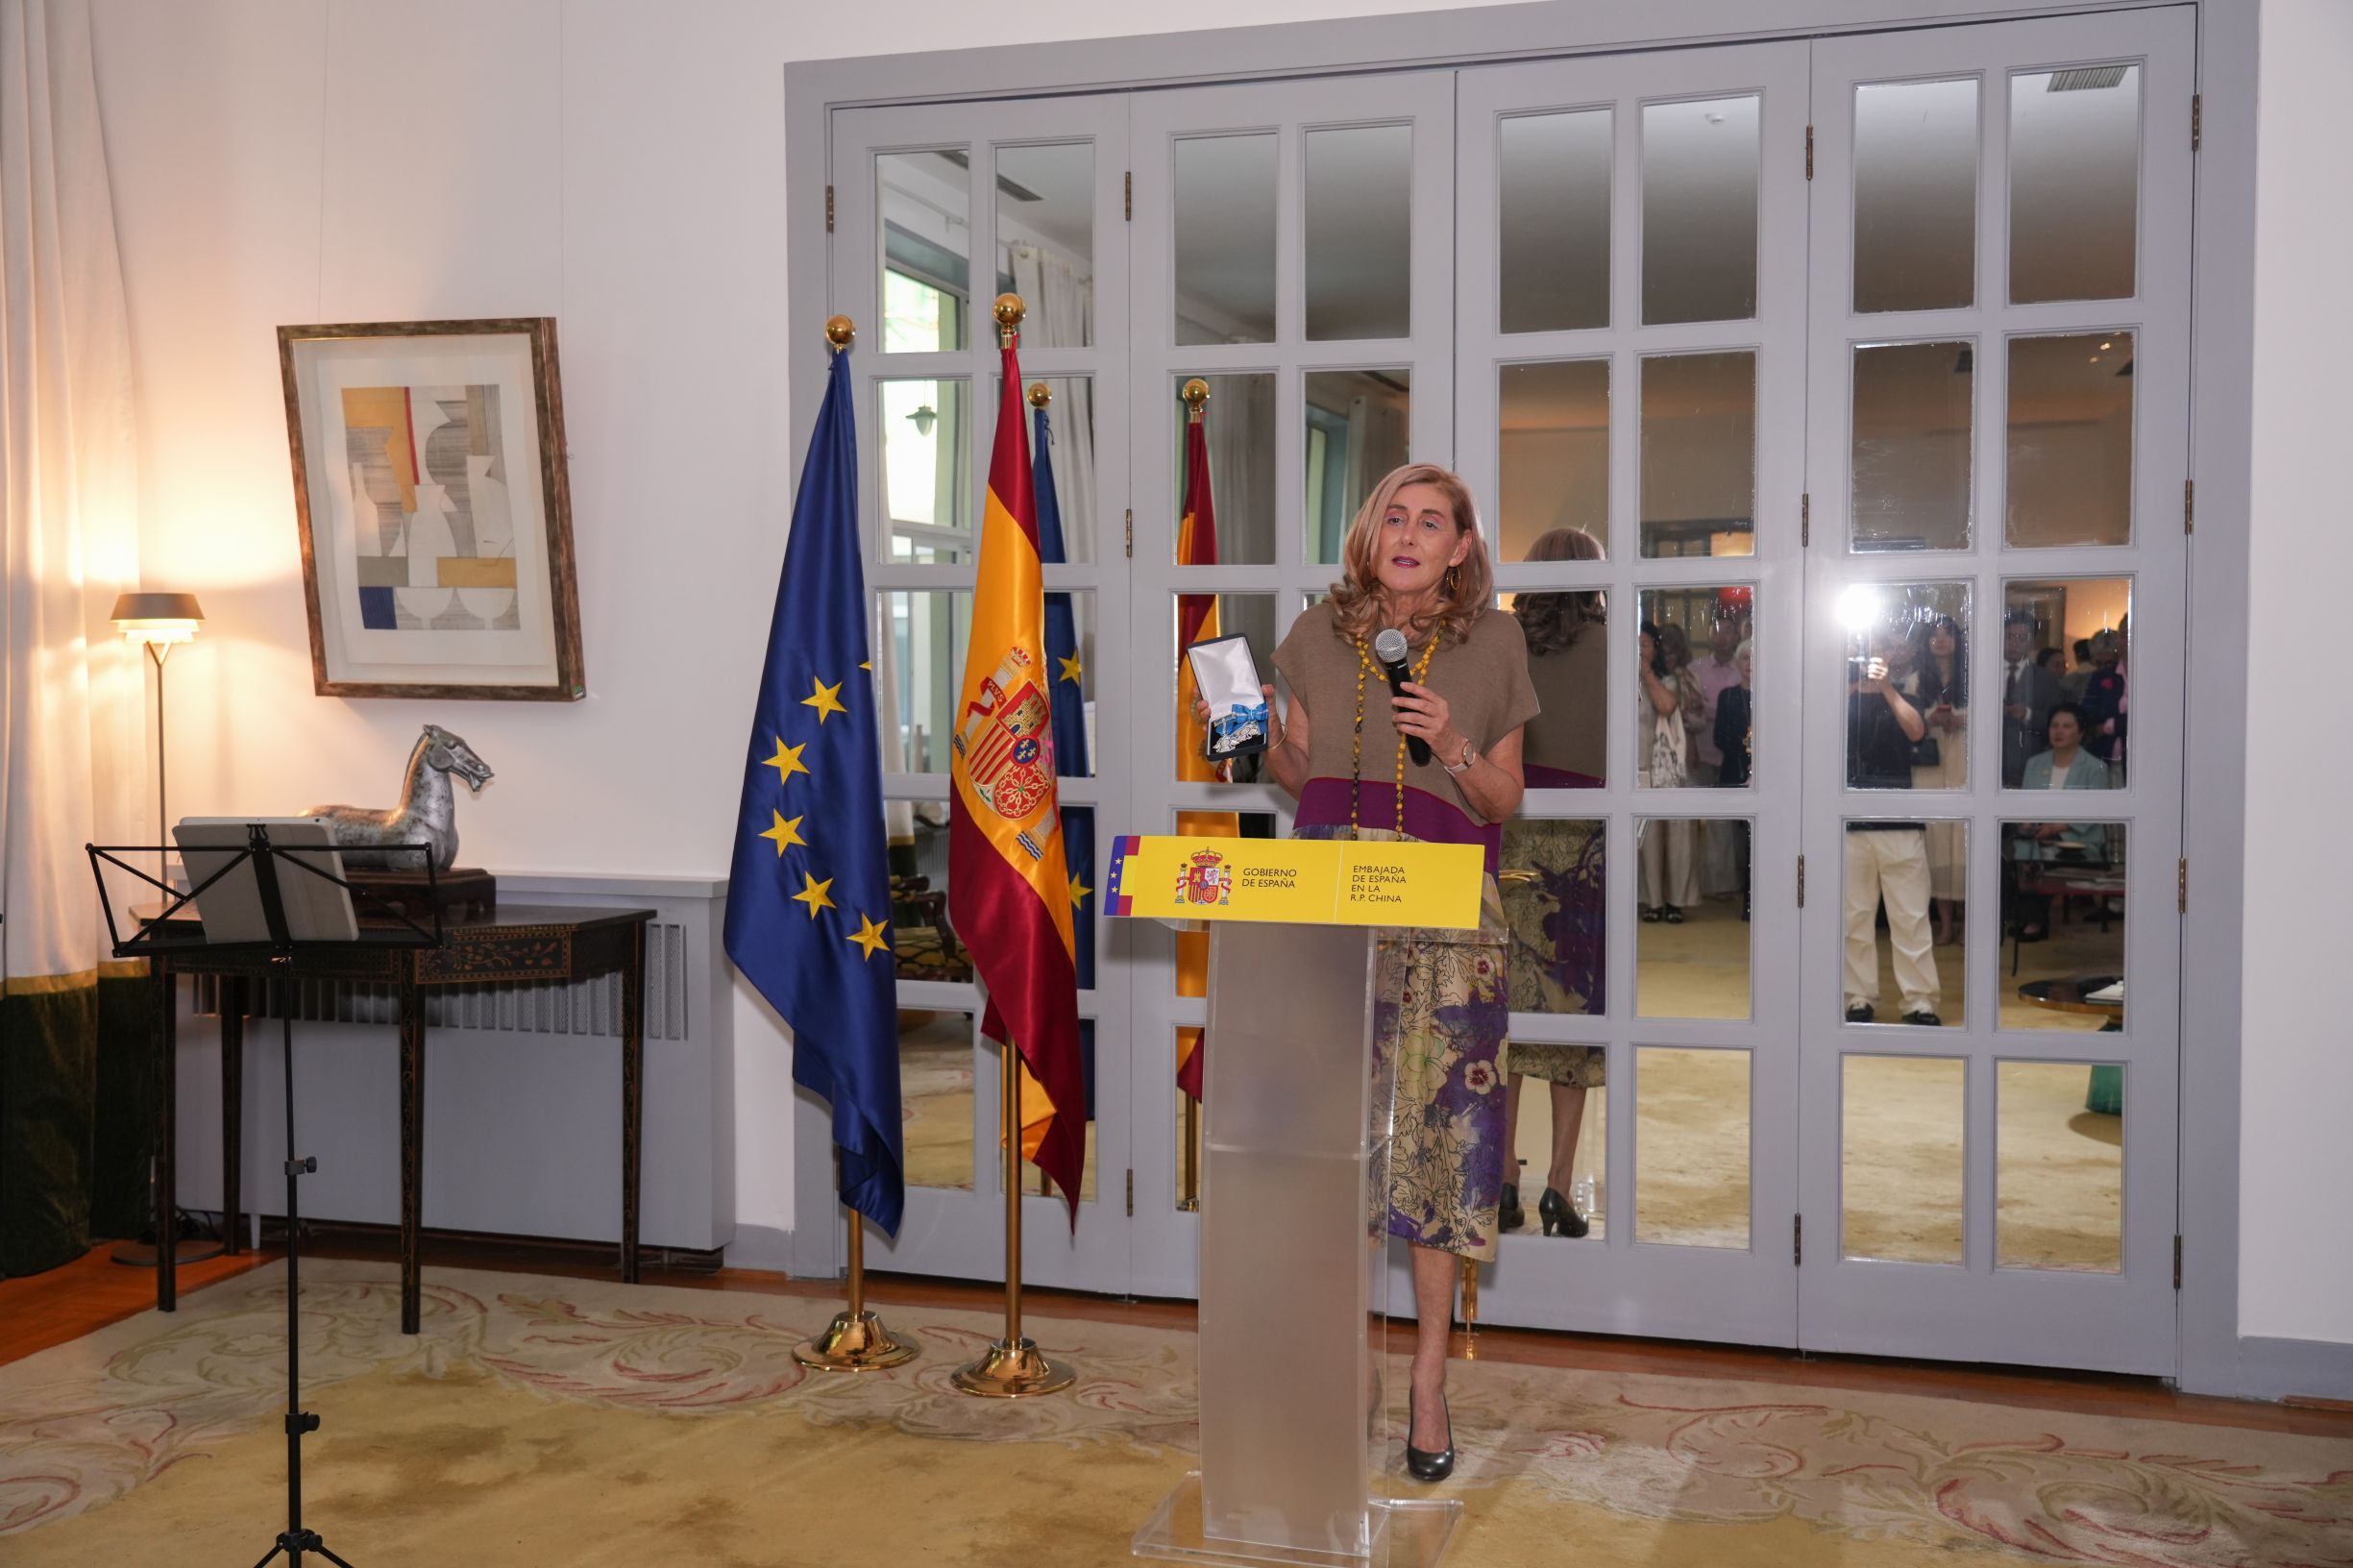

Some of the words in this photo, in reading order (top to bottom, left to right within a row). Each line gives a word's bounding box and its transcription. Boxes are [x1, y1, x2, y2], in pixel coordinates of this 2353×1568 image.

[1242, 868, 1297, 877] GOBIERNO
[1353, 865, 1405, 875] EMBAJADA
[1241, 878, 1255, 888] DE
[1258, 877, 1295, 888] ESPAÑA
[1352, 874, 1365, 883] DE
[1368, 874, 1407, 884] ESPAÑA
[1351, 884, 1365, 893] EN
[1368, 884, 1381, 893] LA
[1350, 894, 1366, 902] R.P.
[1368, 894, 1402, 903] CHINA
